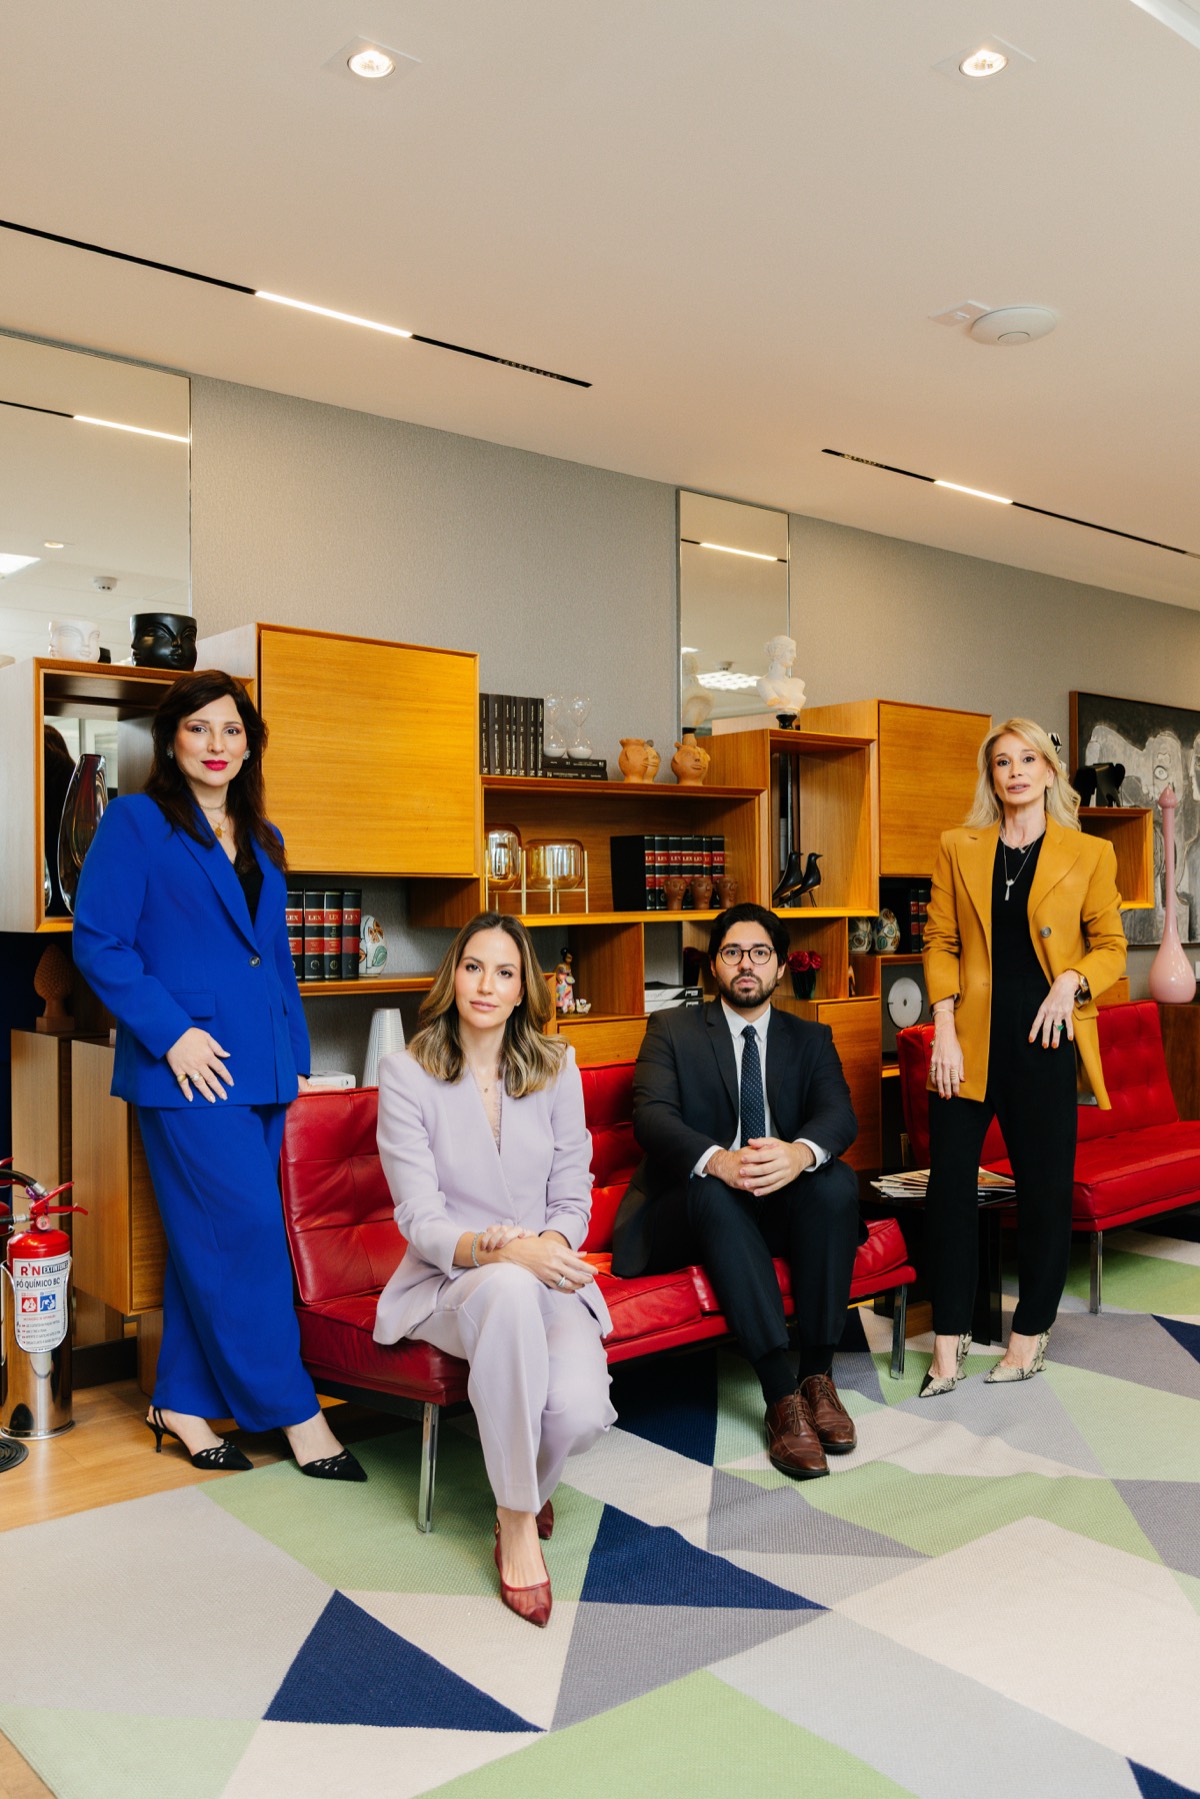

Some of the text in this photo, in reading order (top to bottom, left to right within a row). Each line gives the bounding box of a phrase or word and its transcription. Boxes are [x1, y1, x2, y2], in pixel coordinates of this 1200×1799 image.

[16, 1277, 60, 1289] PÓ QUÍMICO BC
